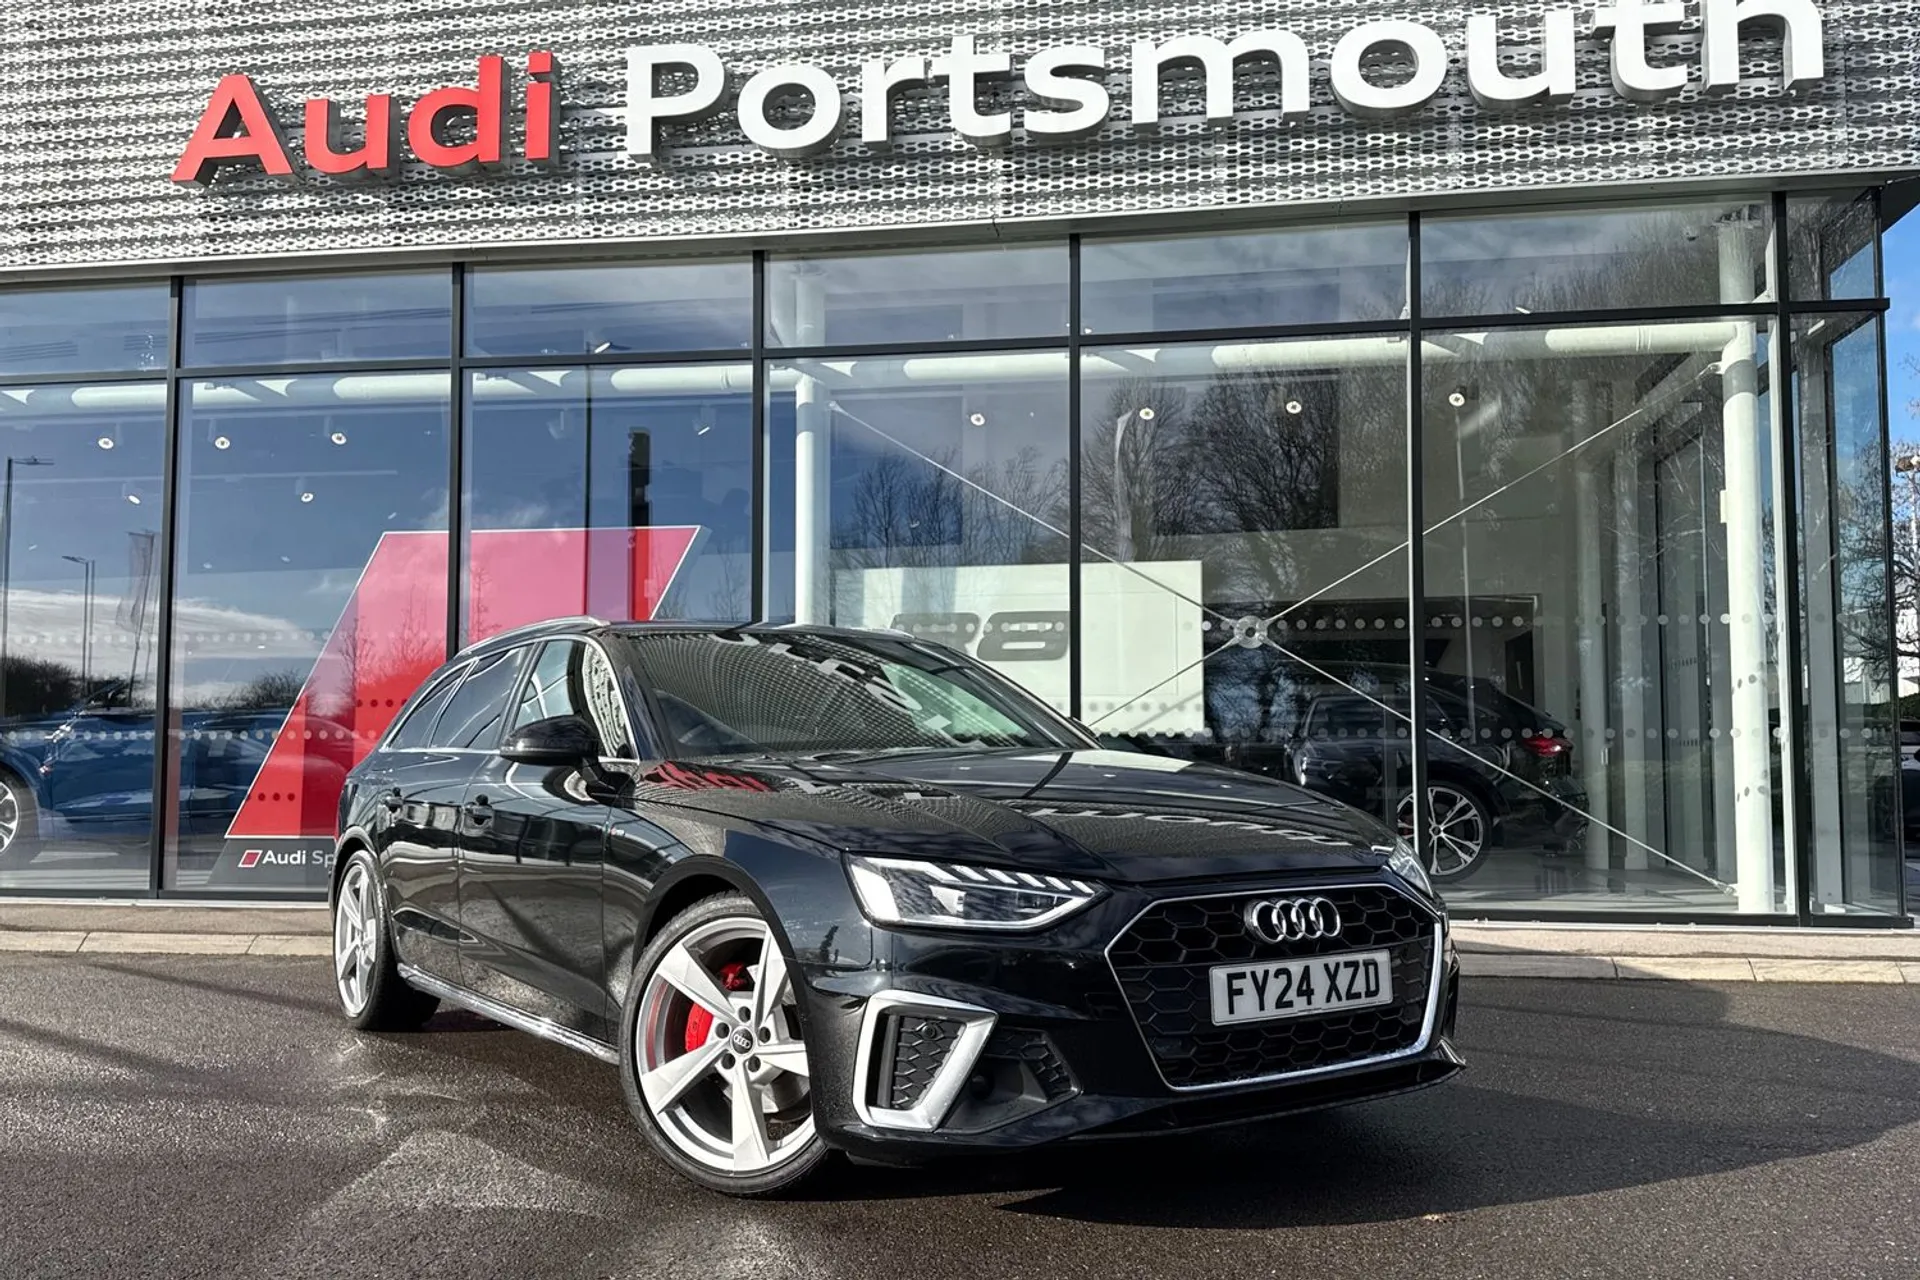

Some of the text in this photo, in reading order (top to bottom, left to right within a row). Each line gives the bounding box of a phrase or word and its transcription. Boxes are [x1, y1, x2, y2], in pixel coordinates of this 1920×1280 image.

[170, 0, 1824, 182] Audi Portsmouth
[261, 849, 307, 864] Audi
[1226, 958, 1380, 1015] FY24 XZD
